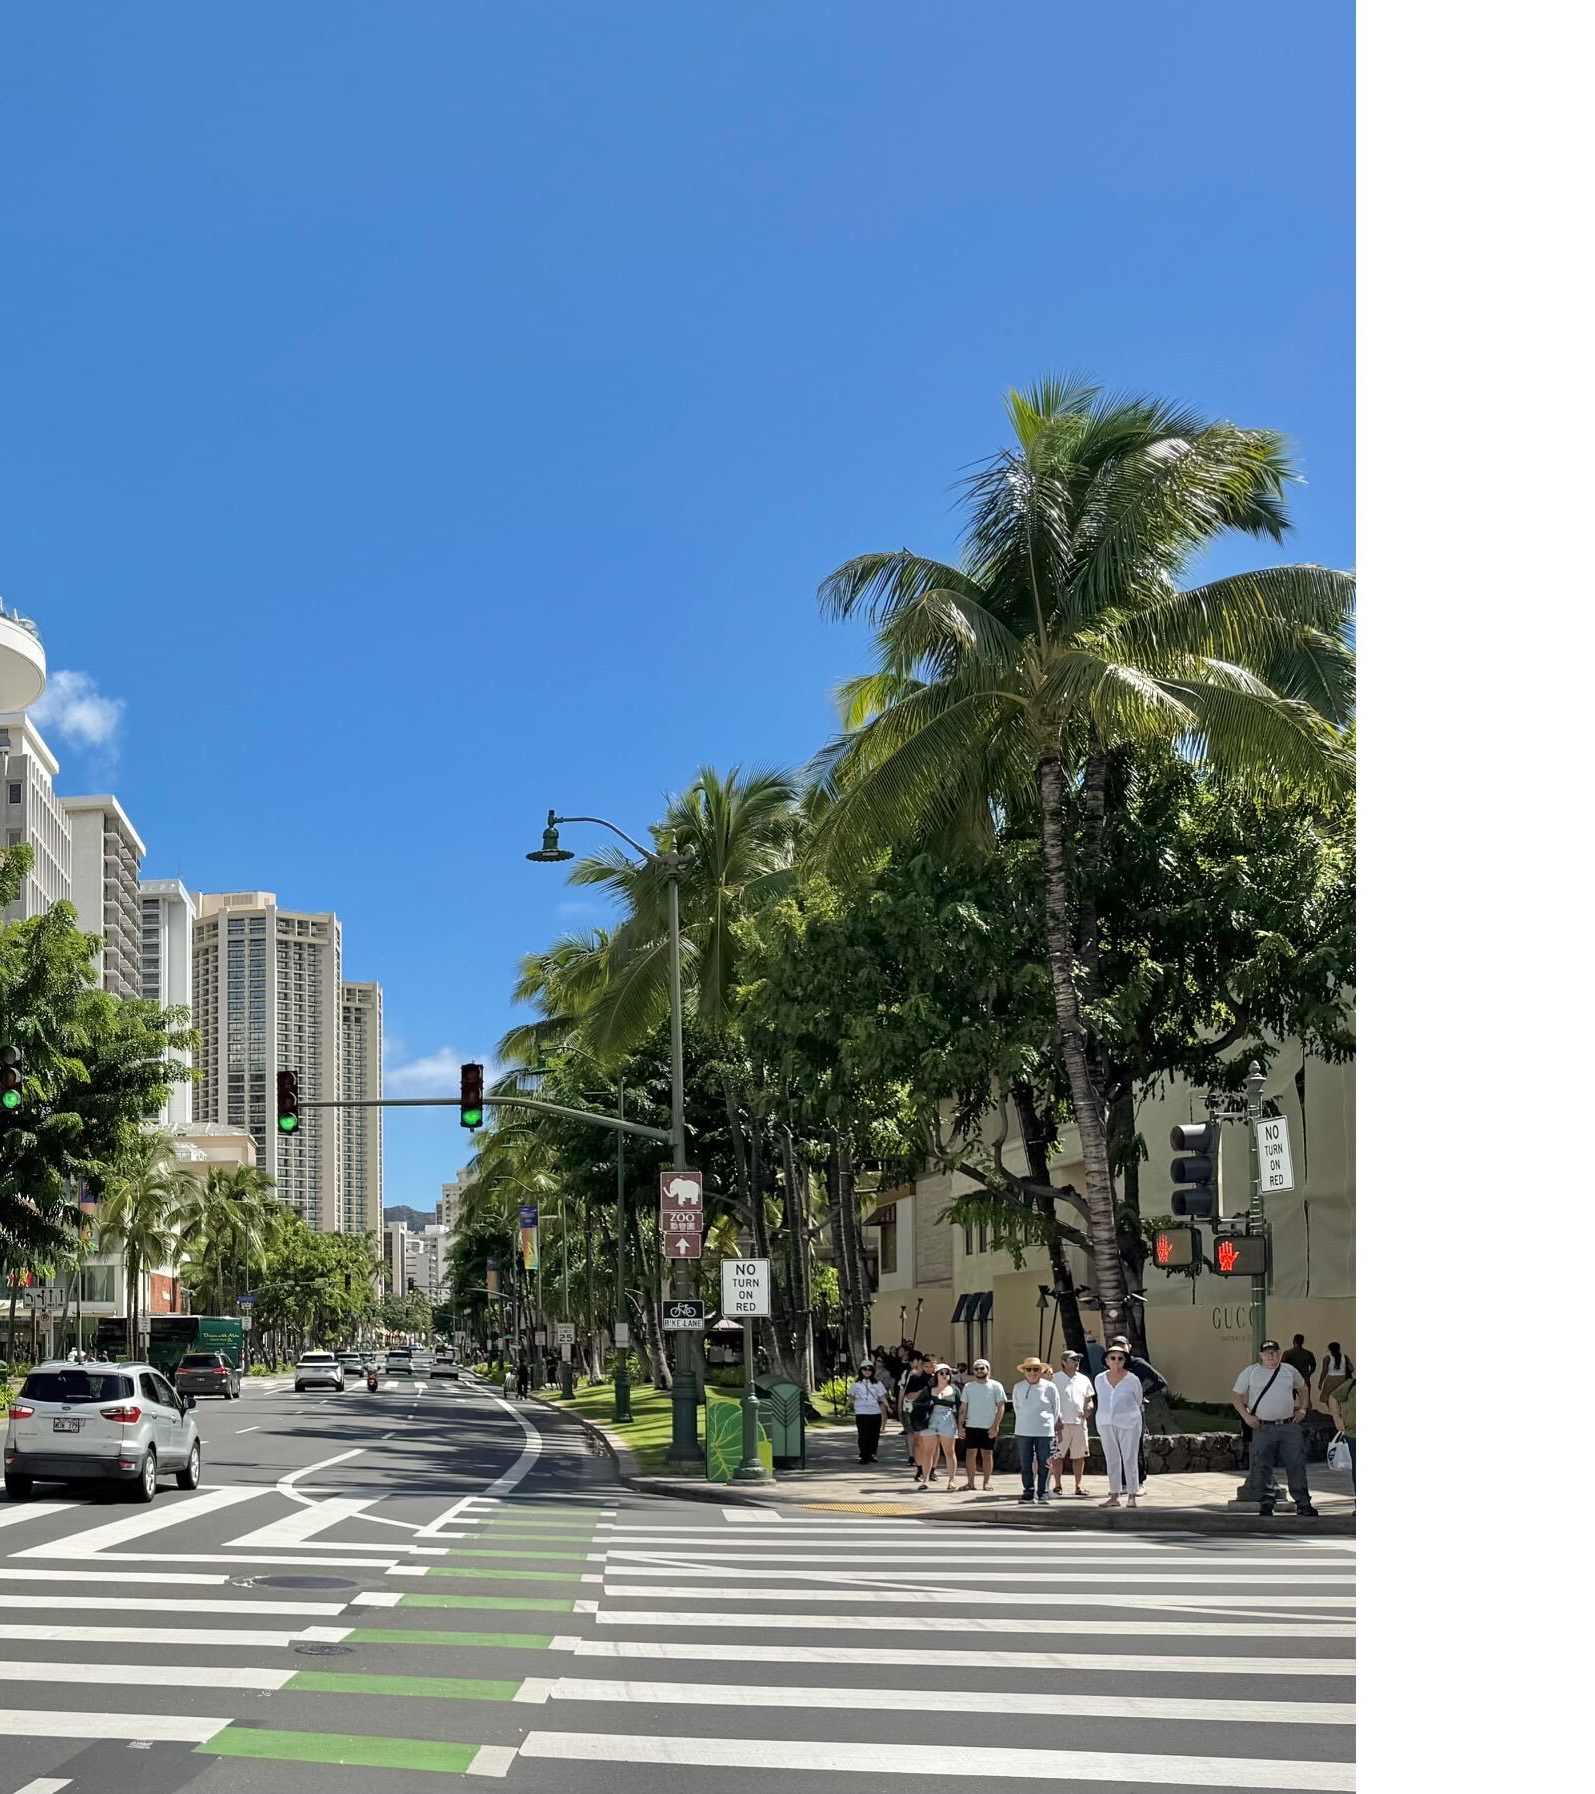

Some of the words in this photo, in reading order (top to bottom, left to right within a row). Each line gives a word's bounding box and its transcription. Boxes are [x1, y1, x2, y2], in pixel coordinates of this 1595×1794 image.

[1265, 1125, 1279, 1140] NO
[1264, 1143, 1283, 1156] TURN
[1270, 1159, 1281, 1171] ON
[1269, 1174, 1284, 1187] RED
[669, 1213, 696, 1222] ZOO
[735, 1264, 756, 1276] NO
[732, 1278, 760, 1288] TURN
[738, 1290, 753, 1300] ON
[736, 1302, 756, 1312] RED
[664, 1319, 681, 1328] BIKE
[683, 1319, 702, 1328] LANE
[559, 1334, 573, 1342] 25
